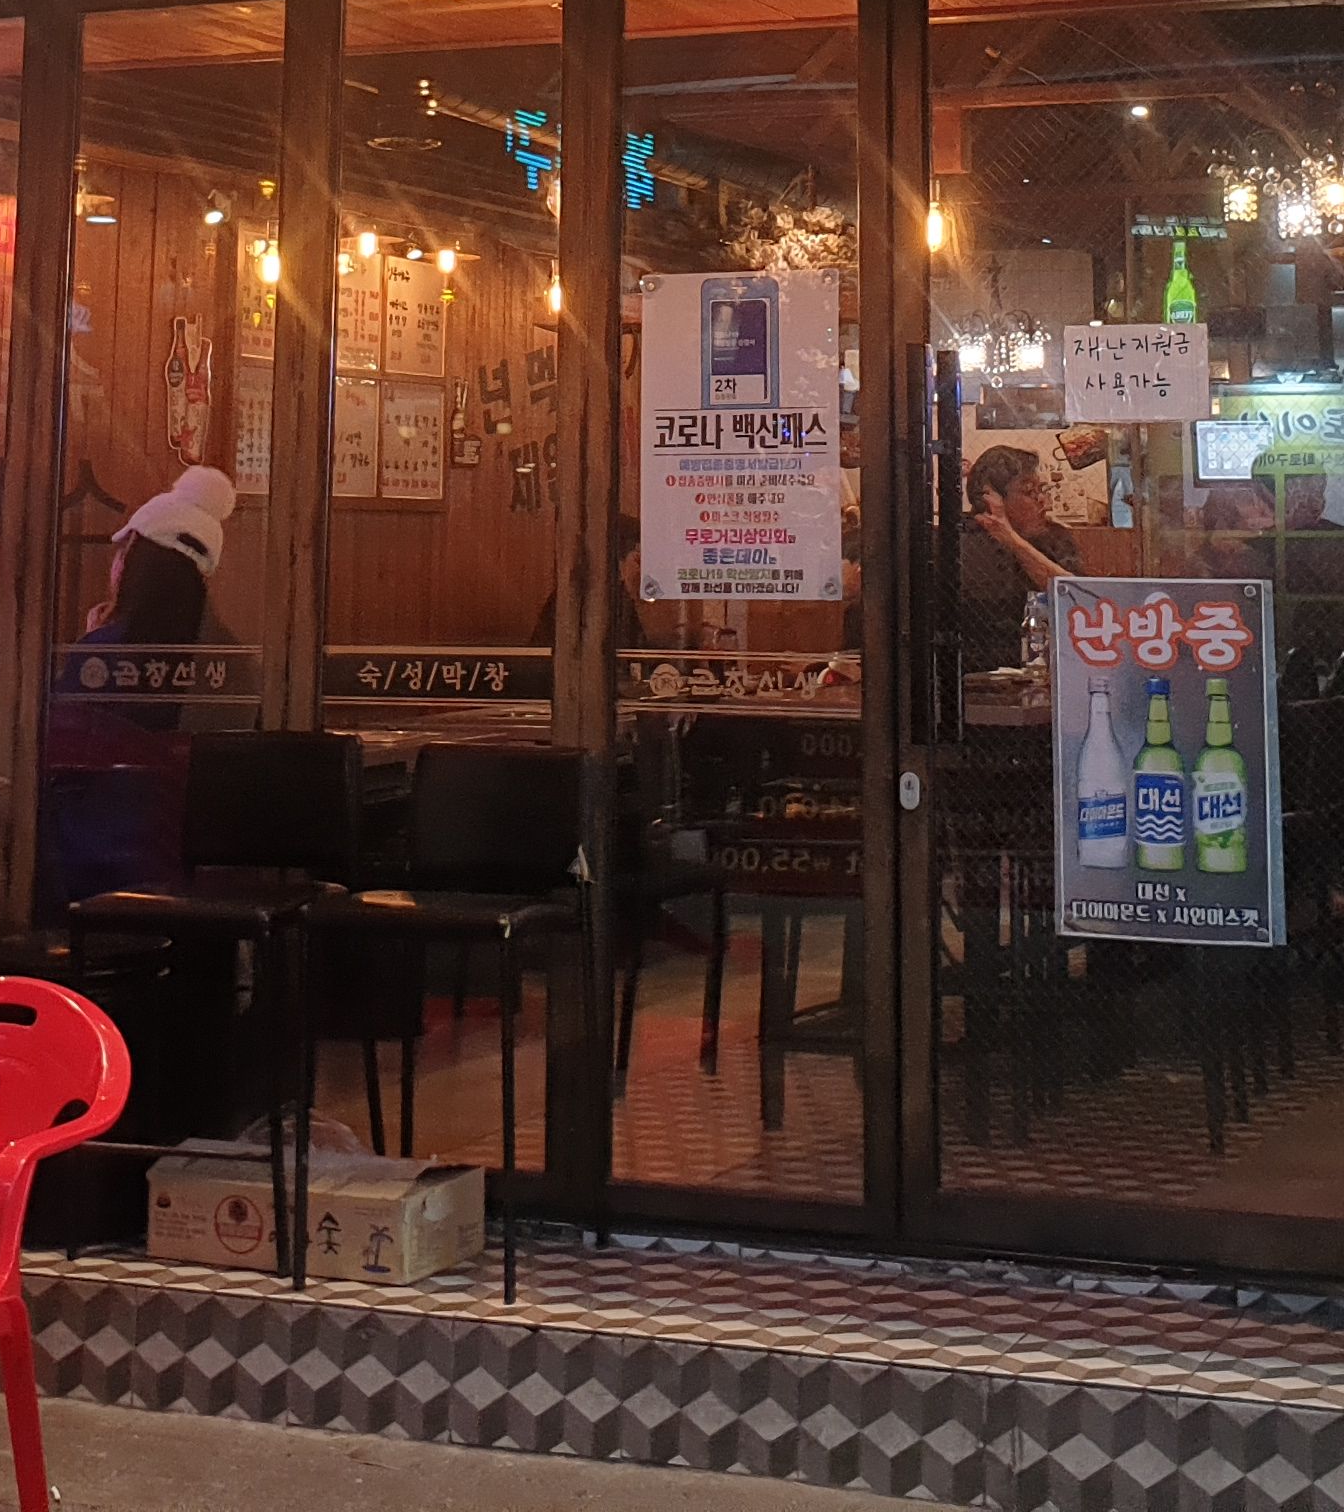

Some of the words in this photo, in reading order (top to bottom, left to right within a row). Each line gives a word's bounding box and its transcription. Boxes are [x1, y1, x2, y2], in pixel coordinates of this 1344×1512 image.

[714, 378, 737, 394] 2차
[653, 414, 724, 450] 코로나
[732, 412, 828, 450] 백신패스
[1069, 599, 1252, 670] 난방중
[112, 660, 228, 689] 곱창선생
[1138, 787, 1182, 813] 대선
[1198, 791, 1243, 818] 대선
[1137, 882, 1170, 902] 대선
